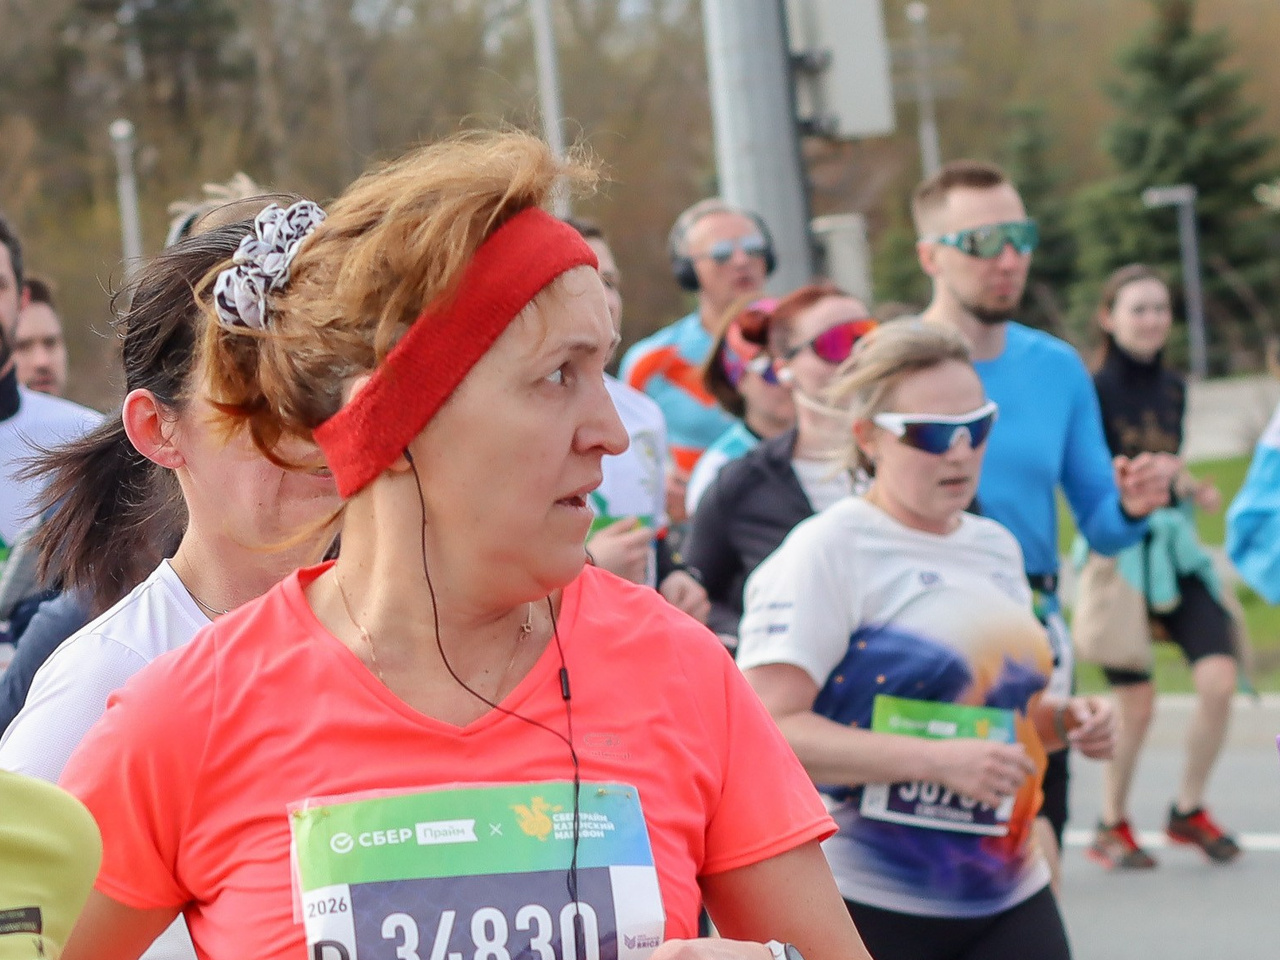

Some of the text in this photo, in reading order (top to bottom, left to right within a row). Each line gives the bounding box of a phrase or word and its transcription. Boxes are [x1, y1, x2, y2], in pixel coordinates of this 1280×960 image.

[358, 824, 466, 847] СБЕР Прайм
[308, 897, 348, 918] 2026
